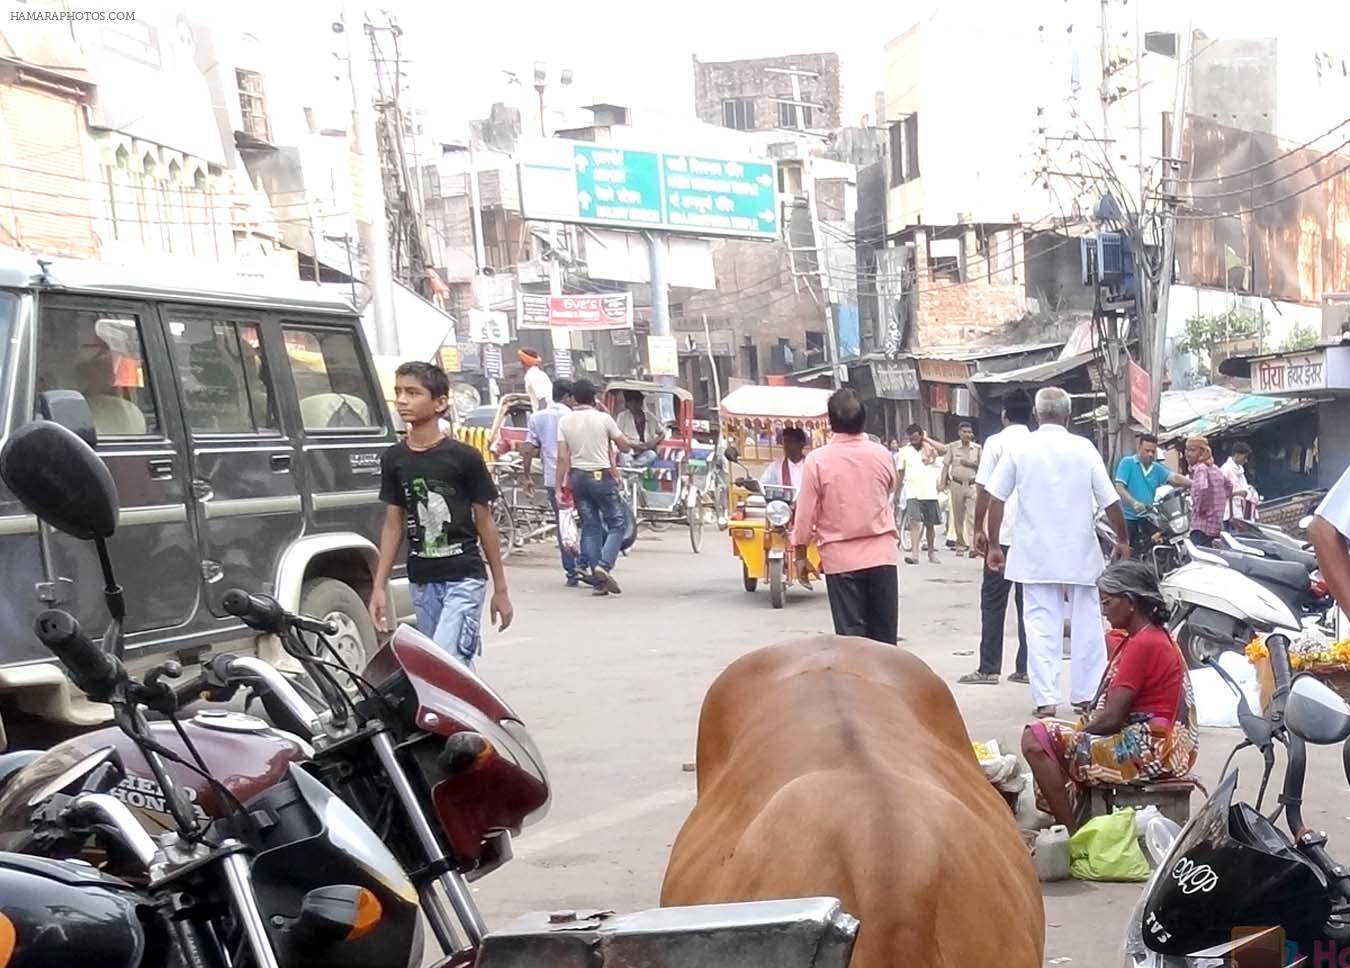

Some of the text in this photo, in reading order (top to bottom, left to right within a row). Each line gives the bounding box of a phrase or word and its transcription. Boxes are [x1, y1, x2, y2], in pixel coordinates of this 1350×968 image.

[110, 787, 210, 820] HONA
[118, 774, 198, 803] HEO
[1146, 911, 1172, 943] TVS
